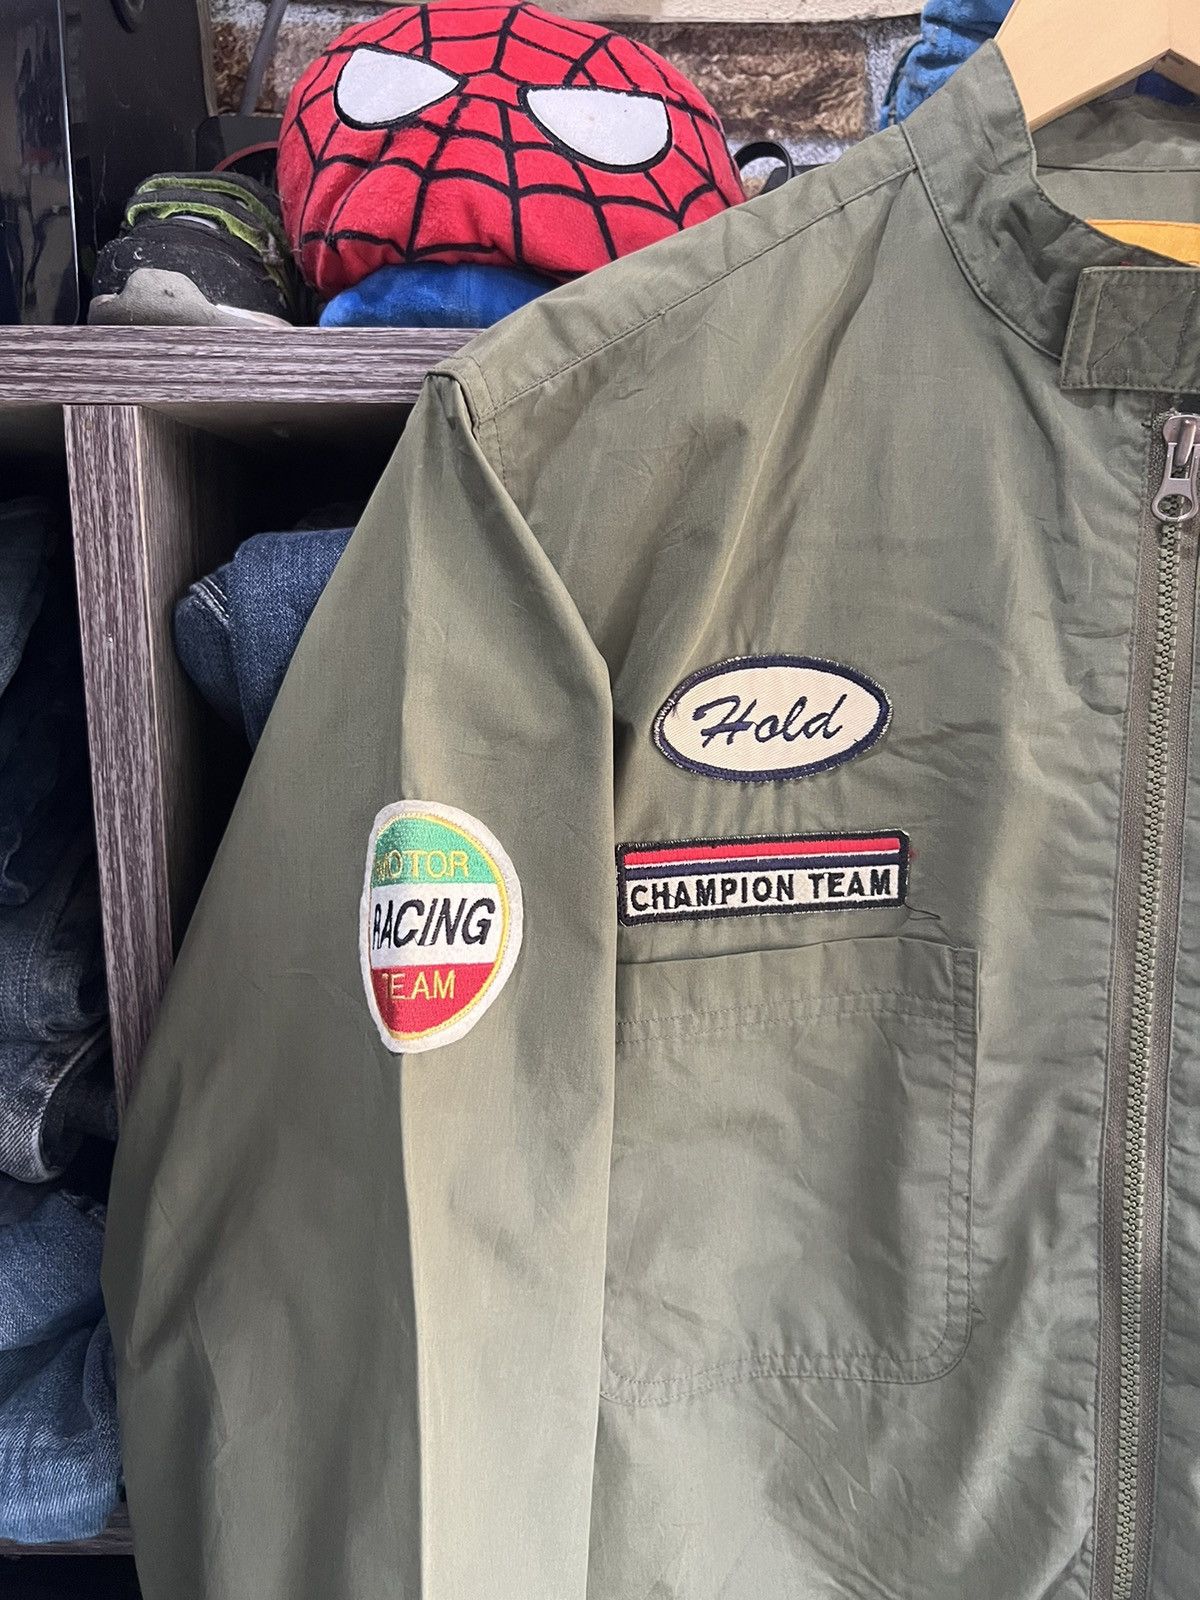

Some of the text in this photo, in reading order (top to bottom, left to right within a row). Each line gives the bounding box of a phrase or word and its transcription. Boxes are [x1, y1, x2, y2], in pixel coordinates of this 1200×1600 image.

[692, 694, 848, 748] Hold
[630, 869, 891, 911] CHAMPION TEAM
[372, 898, 496, 950] RACING
